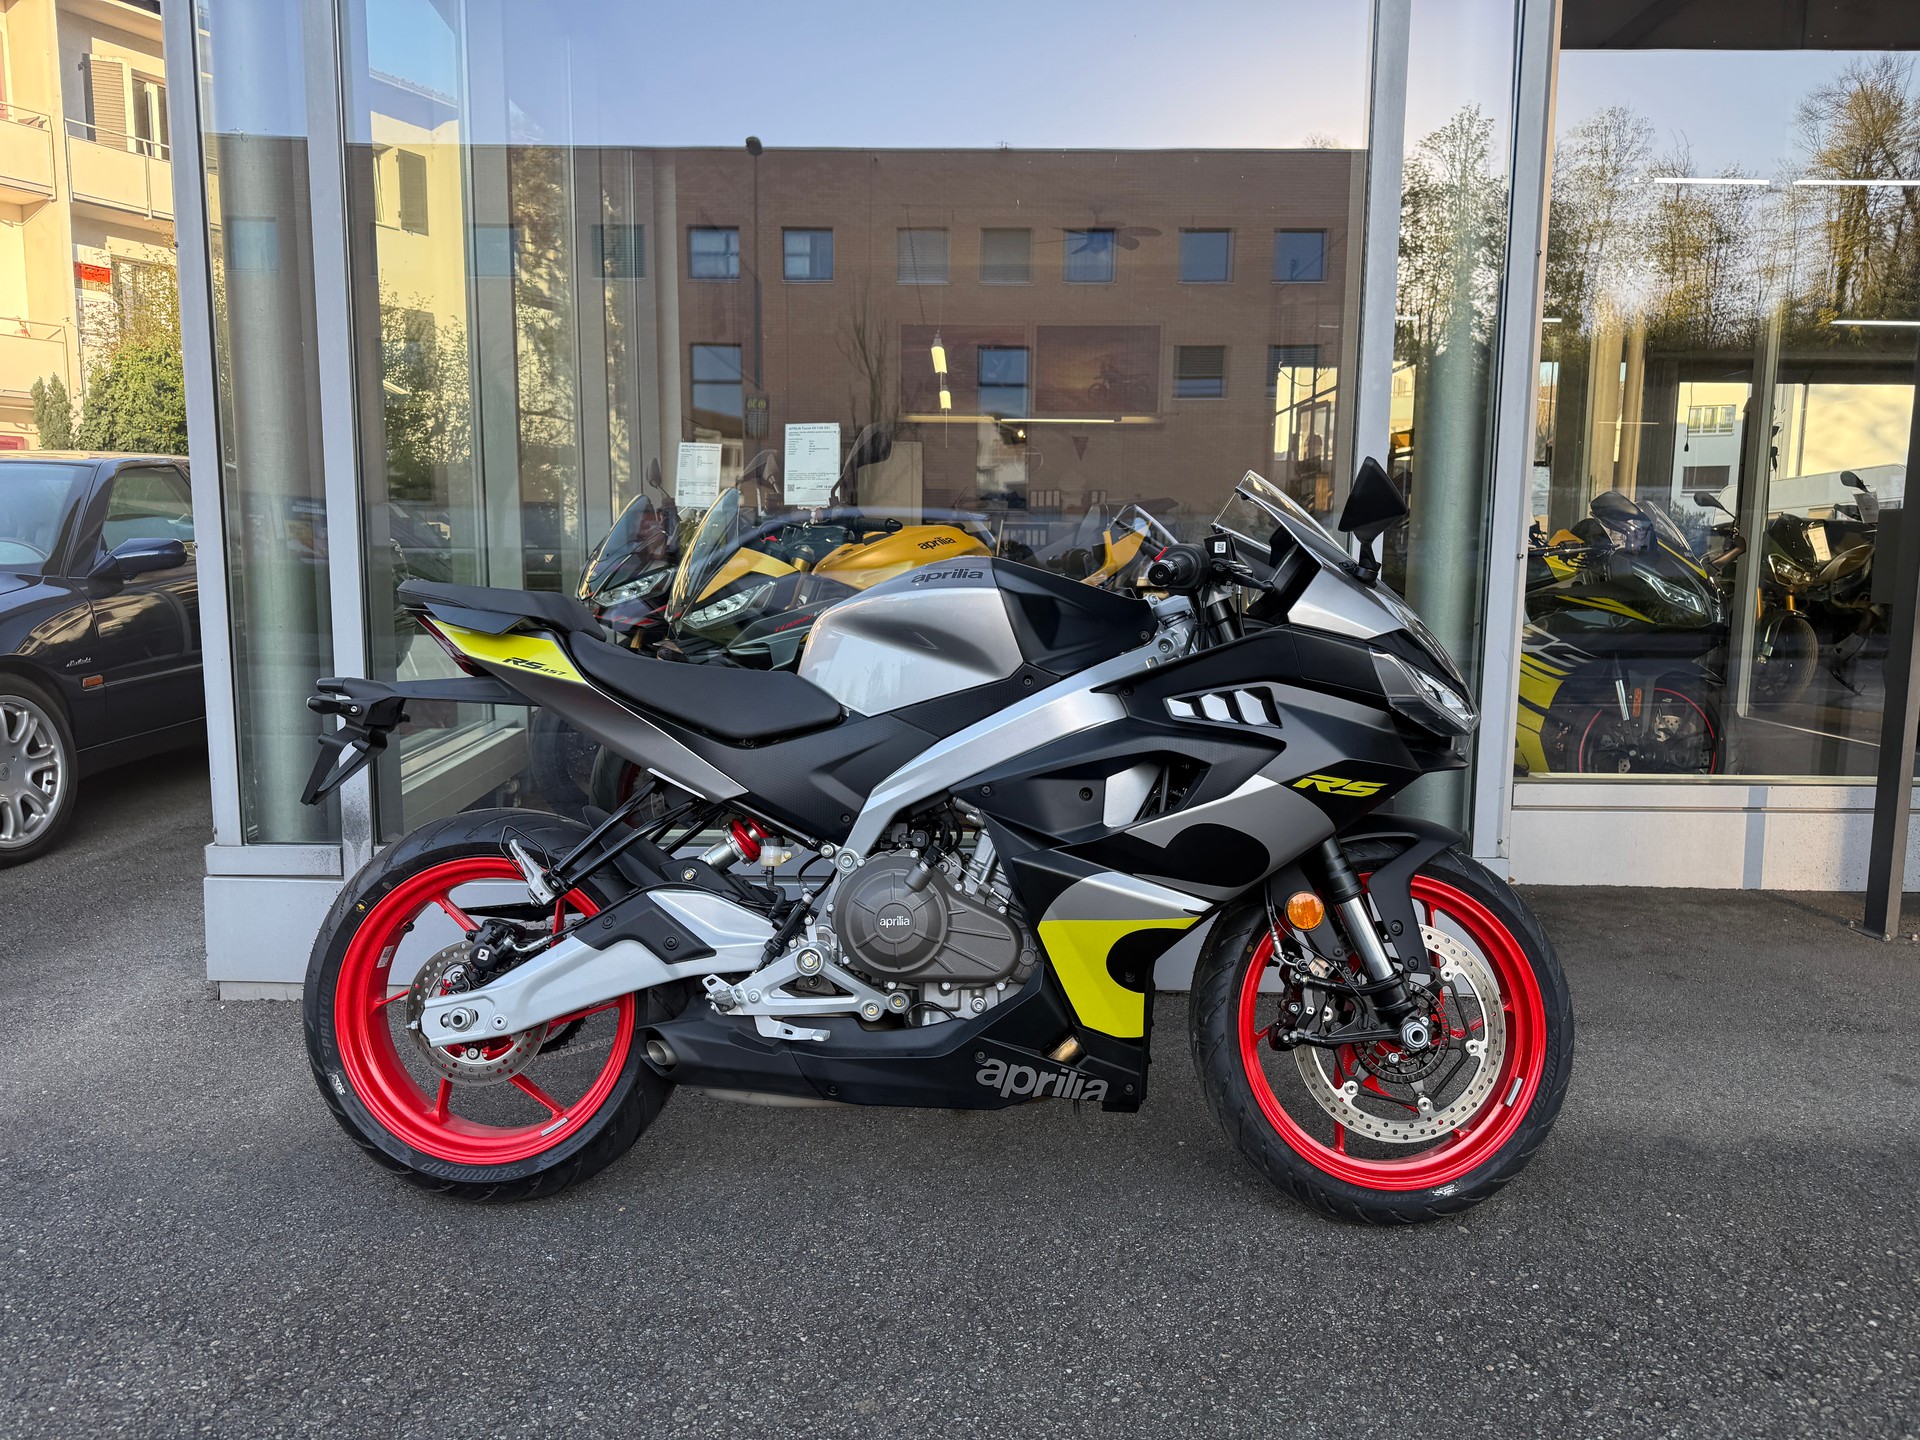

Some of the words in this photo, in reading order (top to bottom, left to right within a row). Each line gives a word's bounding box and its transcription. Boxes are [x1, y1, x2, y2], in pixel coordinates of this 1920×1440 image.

[918, 537, 957, 550] aprilia
[911, 569, 984, 583] aprilia
[502, 657, 547, 670] RS
[1292, 774, 1389, 797] RS
[879, 915, 910, 928] aprilia
[975, 1058, 1109, 1101] aprilia
[419, 1162, 511, 1182] EUROGRIP
